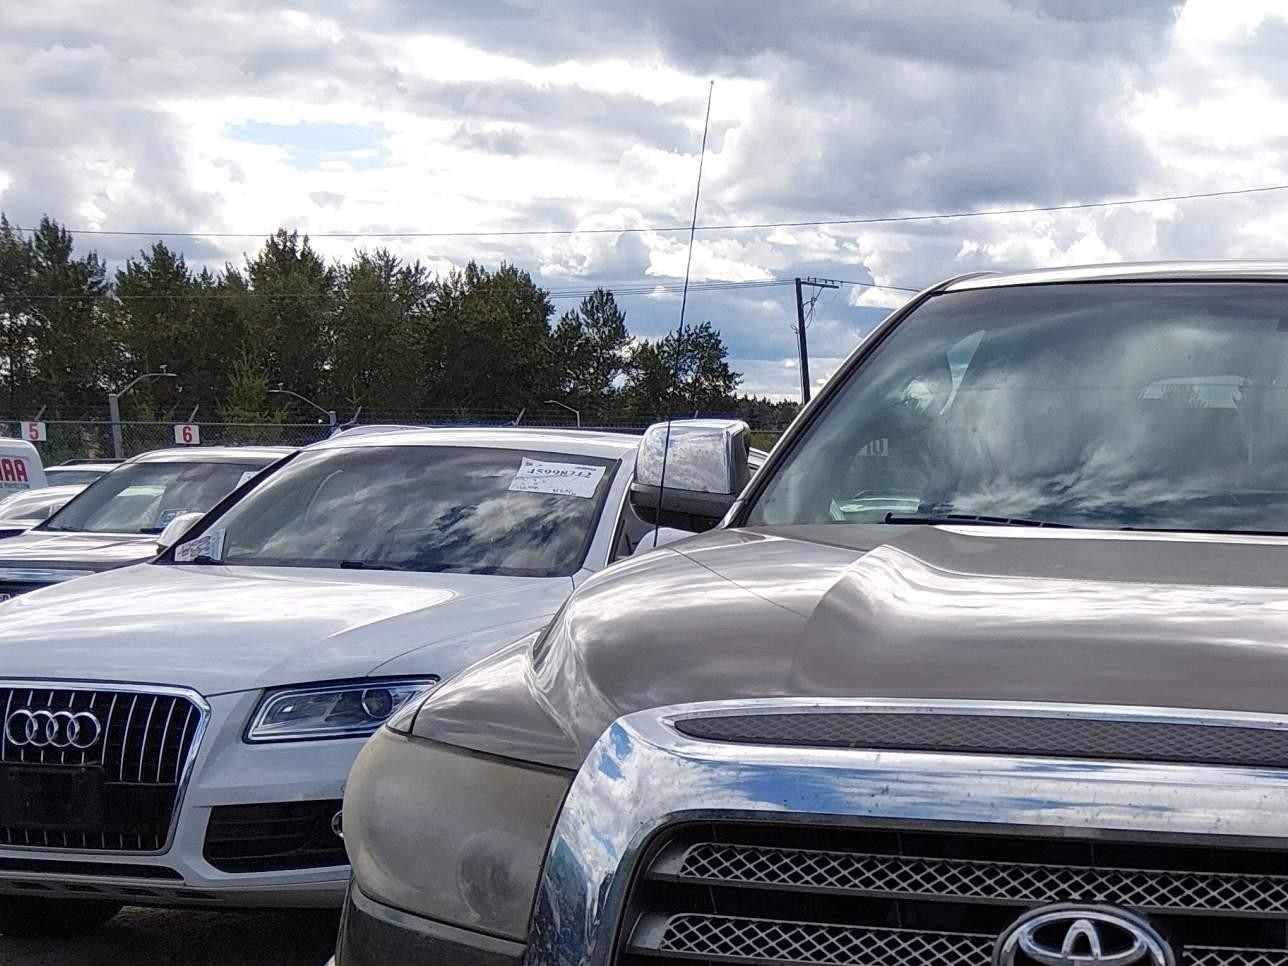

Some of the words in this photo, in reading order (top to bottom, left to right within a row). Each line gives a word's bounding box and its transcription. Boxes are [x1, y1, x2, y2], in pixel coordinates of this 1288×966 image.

[29, 423, 39, 440] 5
[182, 425, 192, 443] 6
[0, 458, 28, 482] AA
